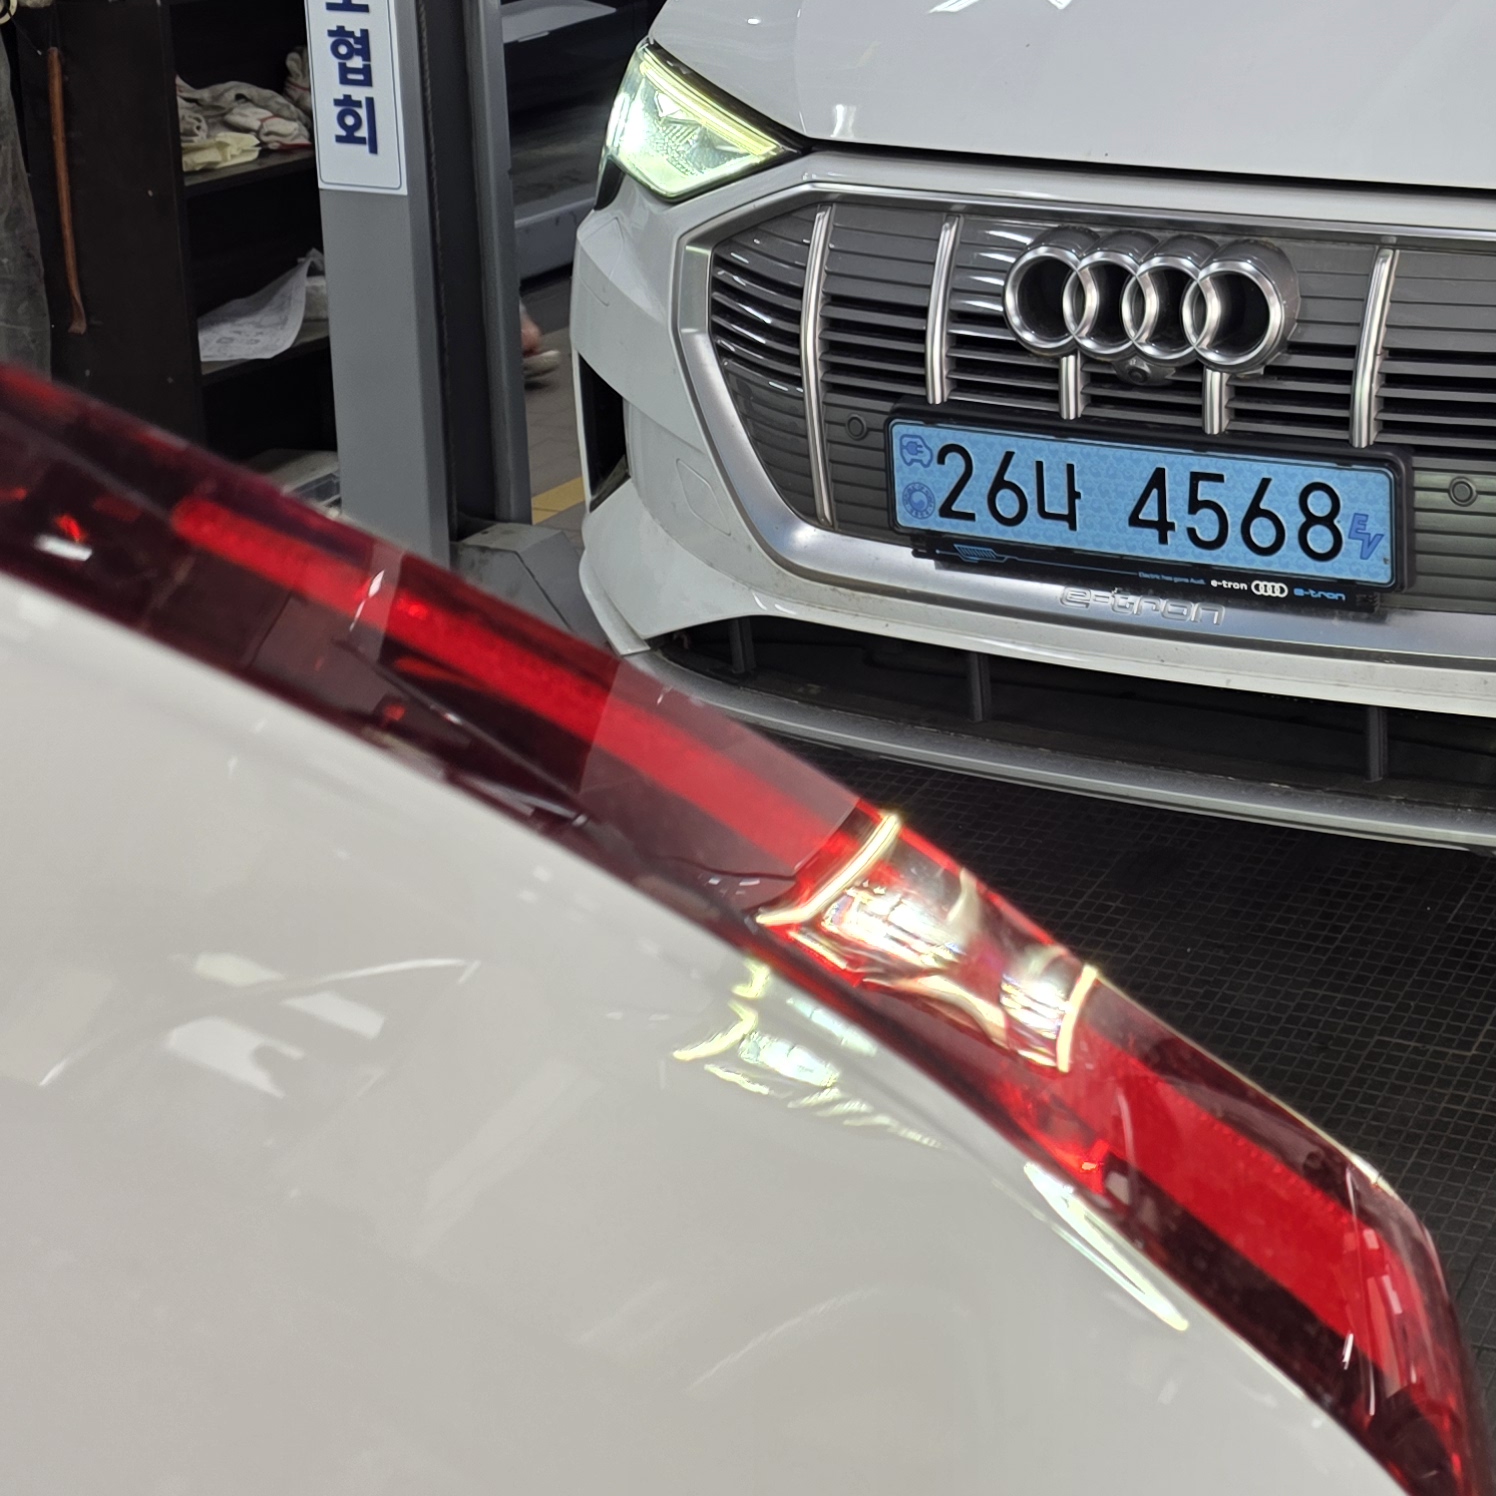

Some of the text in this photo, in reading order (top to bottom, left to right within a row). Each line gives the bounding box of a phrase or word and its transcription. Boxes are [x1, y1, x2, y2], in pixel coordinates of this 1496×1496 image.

[937, 443, 1081, 532] 26나
[1128, 467, 1343, 562] 4568
[1348, 513, 1384, 560] EV
[1060, 585, 1226, 626] e-tron
[1211, 580, 1248, 590] e-tron
[1293, 588, 1346, 601] e-tron
